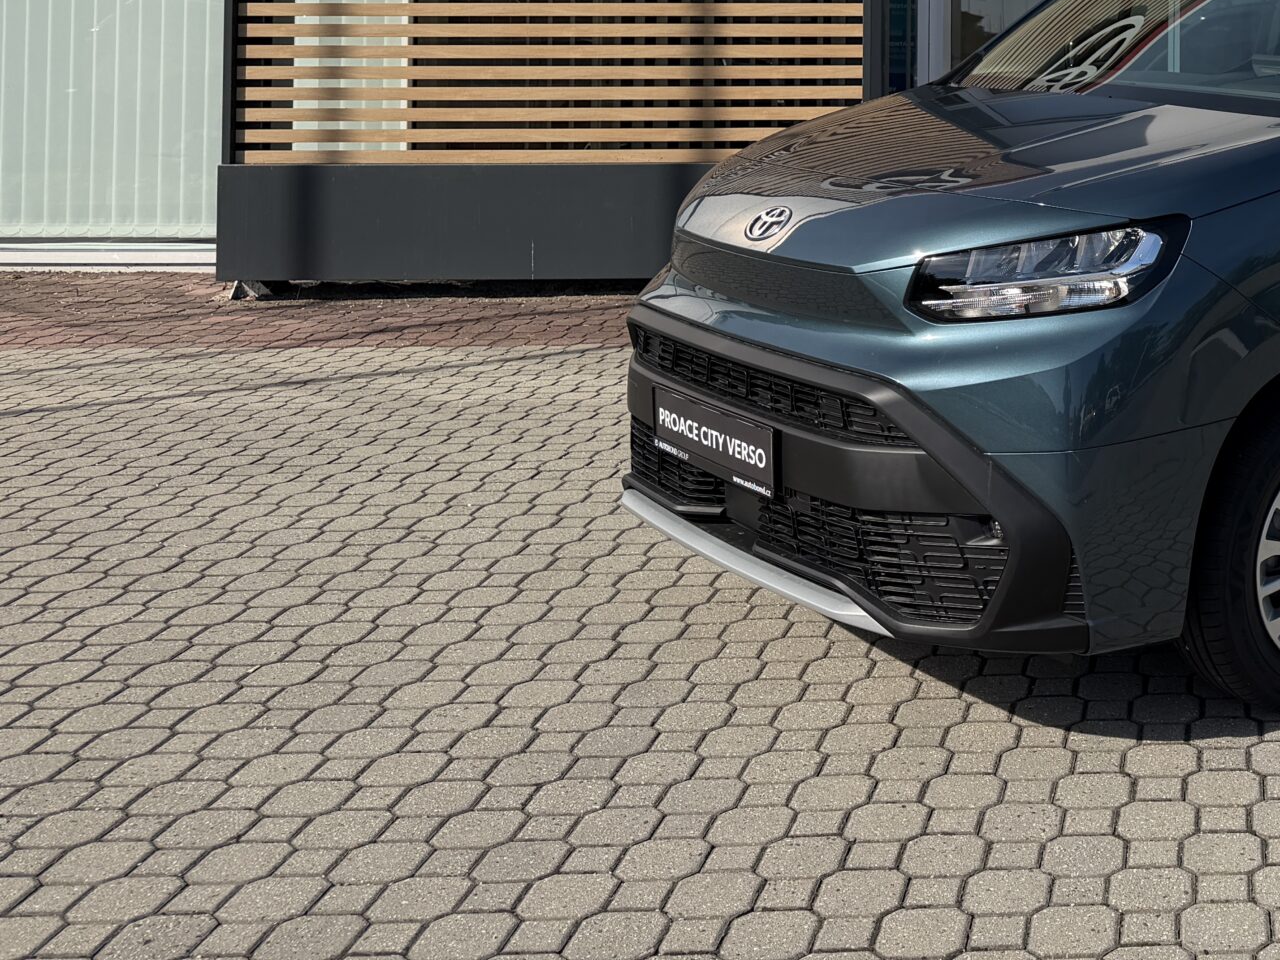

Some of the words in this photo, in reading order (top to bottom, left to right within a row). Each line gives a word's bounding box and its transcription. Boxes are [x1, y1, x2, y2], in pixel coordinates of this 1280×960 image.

[659, 407, 699, 441] PROACE
[700, 426, 725, 452] CITY
[726, 435, 766, 469] VERSO
